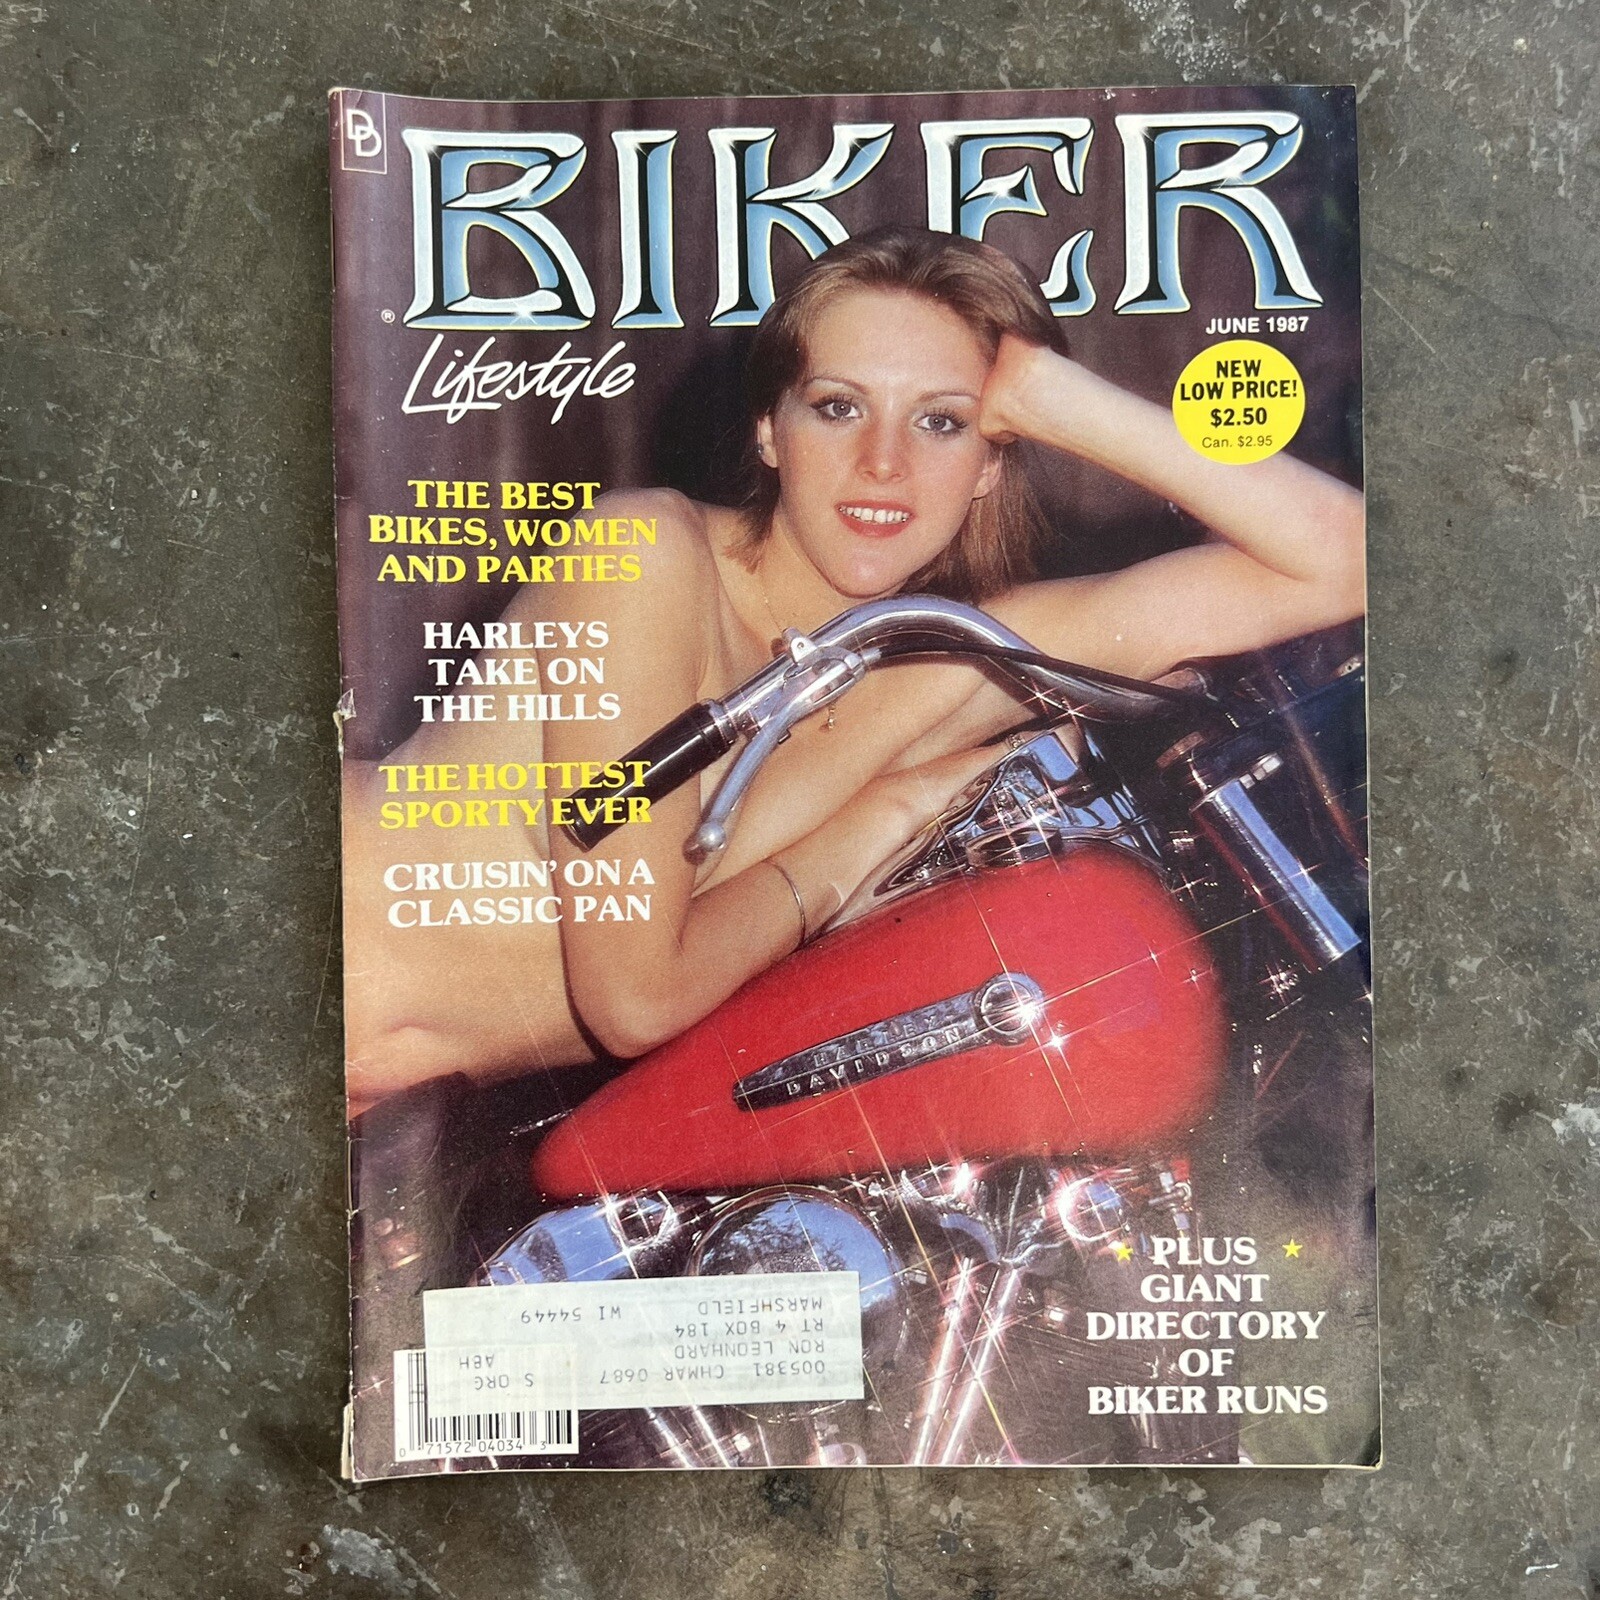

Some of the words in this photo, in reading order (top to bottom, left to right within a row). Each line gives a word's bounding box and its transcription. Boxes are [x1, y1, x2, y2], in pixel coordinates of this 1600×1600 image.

[401, 112, 1324, 330] BIKER
[1205, 317, 1260, 334] JUNE
[1266, 316, 1309, 333] 1987
[401, 334, 637, 424] Lifestyle
[1216, 359, 1261, 379] NEW
[1180, 382, 1224, 401] LOW
[1232, 380, 1297, 399] PRICE!
[1210, 407, 1267, 428] $2.50
[1202, 437, 1232, 448] Can.
[1237, 435, 1273, 448] $2.95
[407, 480, 490, 509] THE
[501, 481, 600, 510] BEST
[368, 515, 497, 550] BIKES,
[503, 518, 657, 546] WOMEN
[377, 554, 466, 582] AND
[477, 554, 642, 583] PARTIES
[423, 621, 609, 649] HARLEYS
[428, 658, 537, 686] TAKE
[547, 657, 605, 684] ON
[414, 695, 496, 723] THE
[507, 693, 621, 721] HILLS
[378, 765, 460, 793] THE
[466, 761, 651, 791] HOTTEST
[379, 799, 545, 829] SPORTY
[551, 797, 652, 825] EVER
[383, 860, 557, 892] CRUISIN'
[564, 858, 621, 886] ON
[629, 858, 655, 885] A
[388, 896, 562, 928] CLASSIC
[574, 894, 651, 922] PAN
[786, 1027, 961, 1095] DAVIDSON
[1151, 1237, 1258, 1265] PLUS
[1140, 1274, 1270, 1303] GIANT
[521, 1307, 582, 1324] 54449
[599, 1306, 622, 1320] WI
[699, 1297, 822, 1316] MARSHFIELD
[675, 1322, 708, 1338] 184
[726, 1320, 760, 1335] BOX
[775, 1320, 786, 1333] 4
[803, 1318, 823, 1333] RT
[1086, 1311, 1326, 1340] DIRECTORY
[675, 1341, 773, 1359] LEONHARD
[789, 1340, 824, 1354] RON
[664, 1364, 724, 1381] CHMAR
[755, 1360, 825, 1377] 005381
[1178, 1349, 1234, 1377] OF
[525, 1373, 534, 1387] S
[600, 1368, 648, 1384] 0687
[1087, 1385, 1207, 1415] BIKER
[1217, 1385, 1328, 1414] RUNS
[427, 1441, 471, 1454] 71572
[479, 1439, 523, 1453] 04034
[540, 1440, 547, 1451] 3
